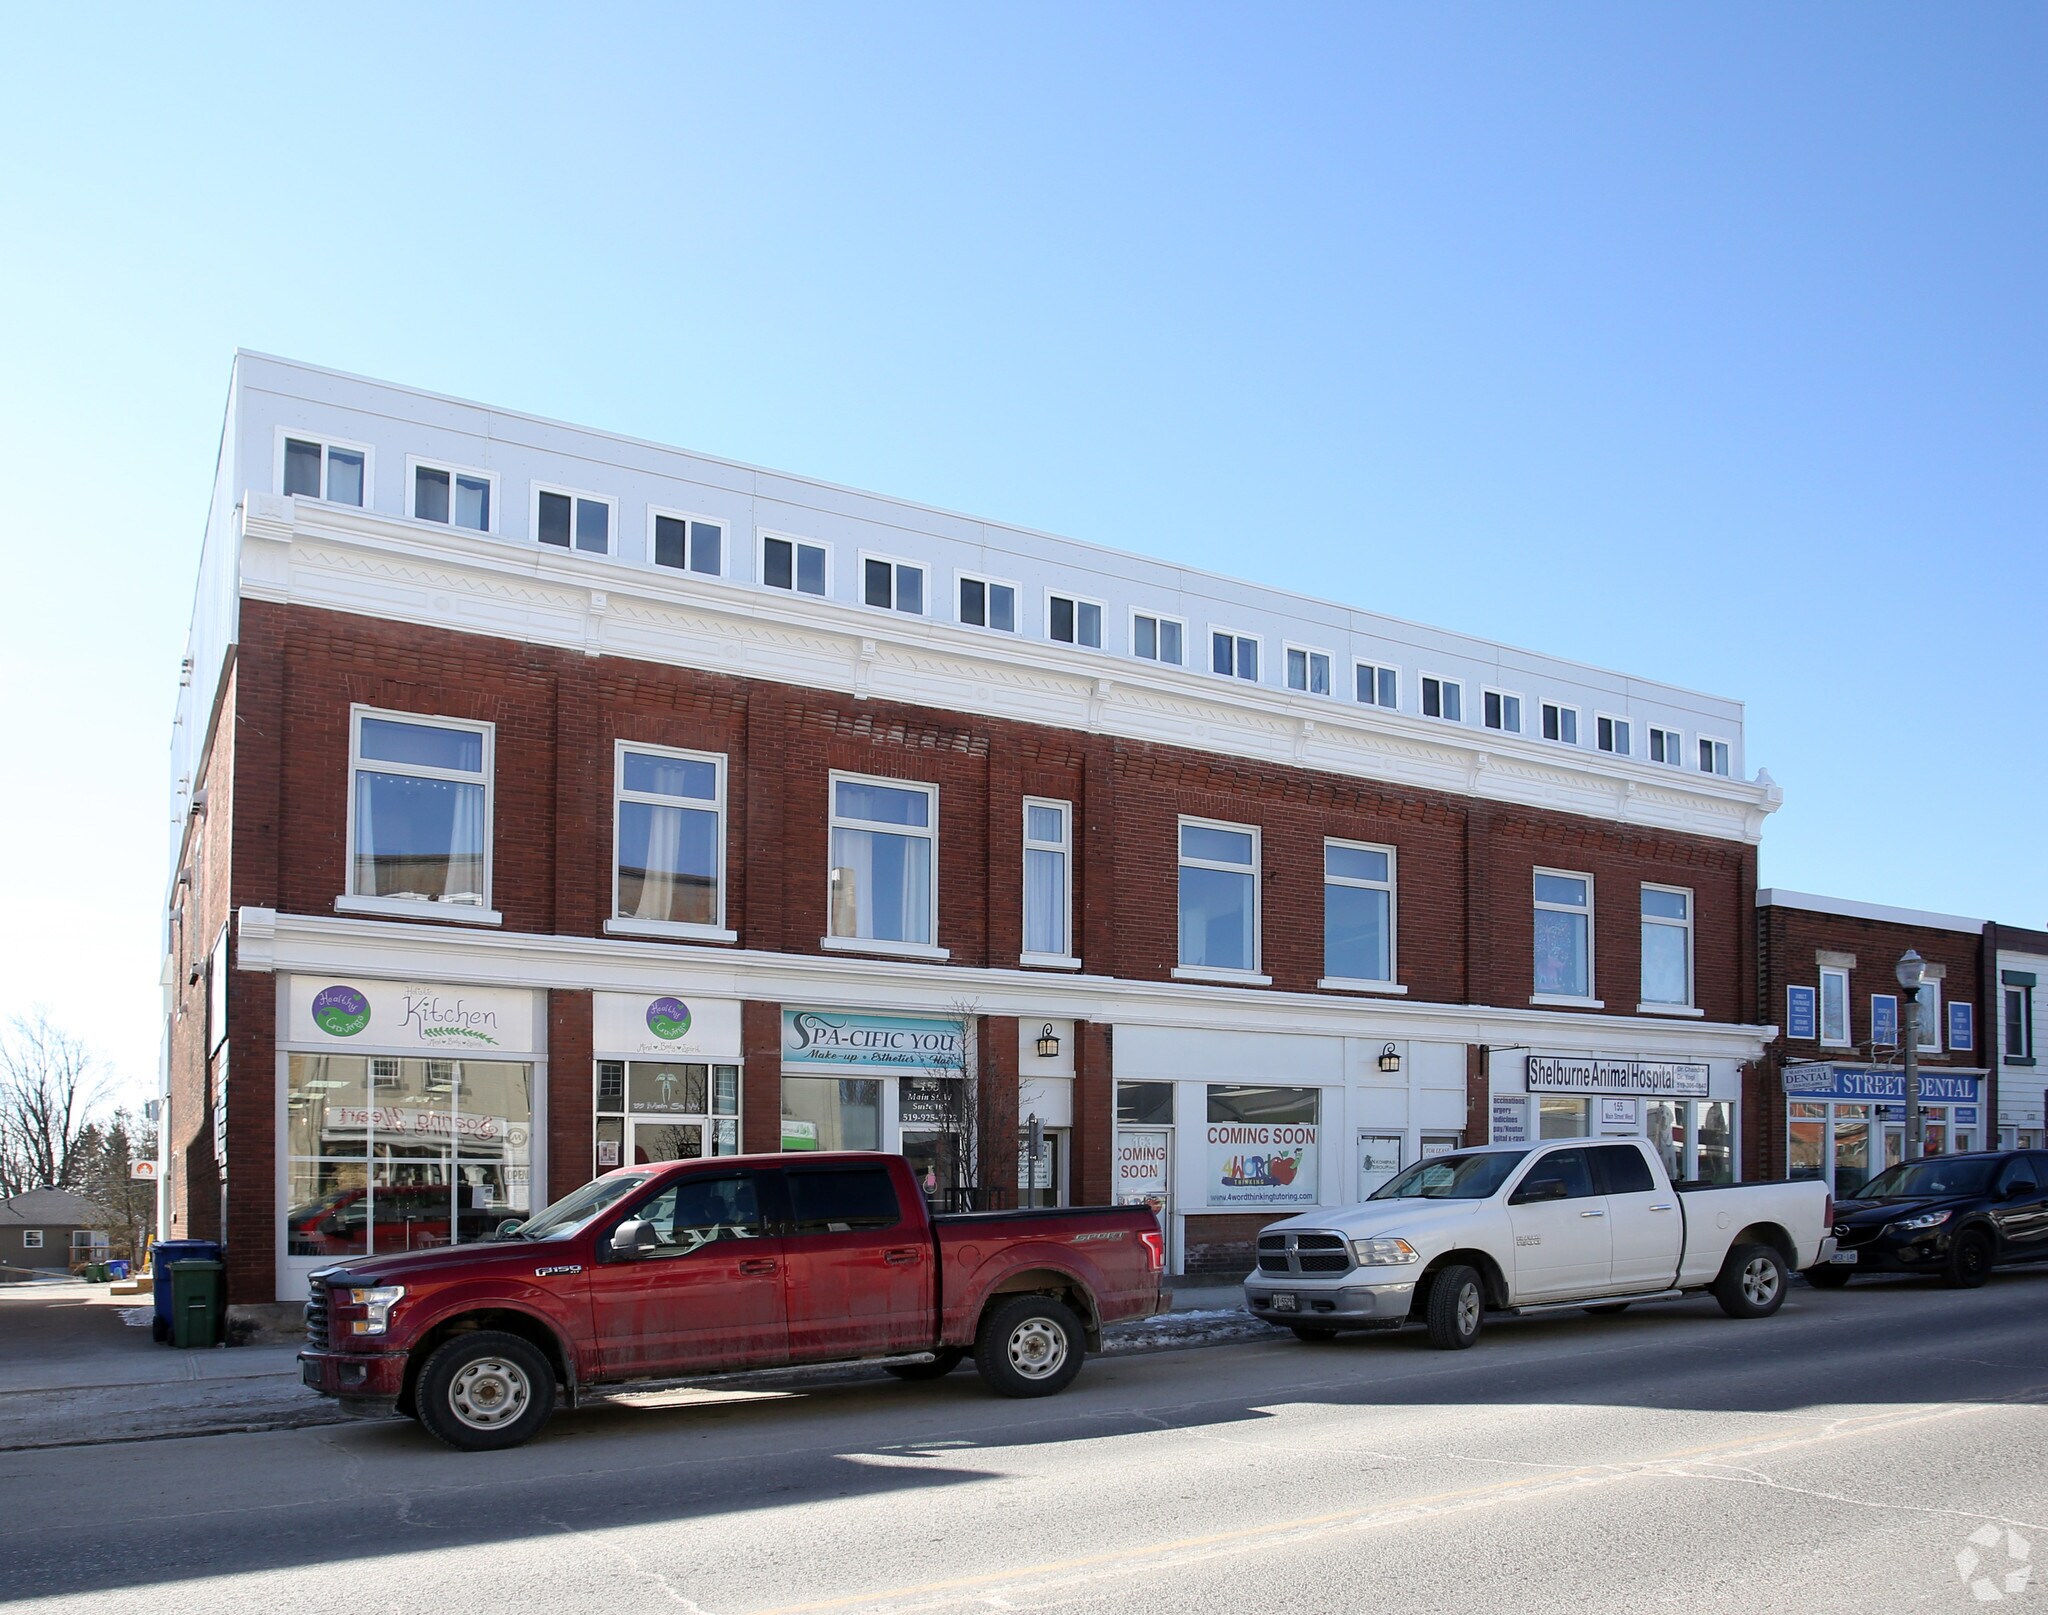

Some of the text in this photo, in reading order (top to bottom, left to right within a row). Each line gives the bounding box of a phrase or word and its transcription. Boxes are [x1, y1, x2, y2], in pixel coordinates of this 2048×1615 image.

[319, 991, 358, 1012] Healthy
[650, 1002, 681, 1019] Healthy
[325, 1016, 365, 1034] Cravings
[398, 996, 498, 1040] Kitchen
[656, 1022, 687, 1036] Cravings
[911, 1033, 957, 1051] YOU
[804, 1049, 859, 1063] Make-up
[870, 1052, 915, 1063] Esthetics
[1530, 1058, 1675, 1093] Shelburne Animal Hospital
[1785, 1072, 1831, 1084] DENTAL
[1843, 1074, 1906, 1096] STREET
[1917, 1077, 1975, 1098] DENTAL
[907, 1092, 929, 1101] Main
[912, 1102, 933, 1110] Suite
[1613, 1102, 1624, 1112] 155
[1133, 1136, 1153, 1147] 163
[1207, 1127, 1316, 1144] COMING SOON
[1121, 1164, 1158, 1178] SOON
[1210, 1193, 1313, 1202] www.4wordthinkingtutoring.com
